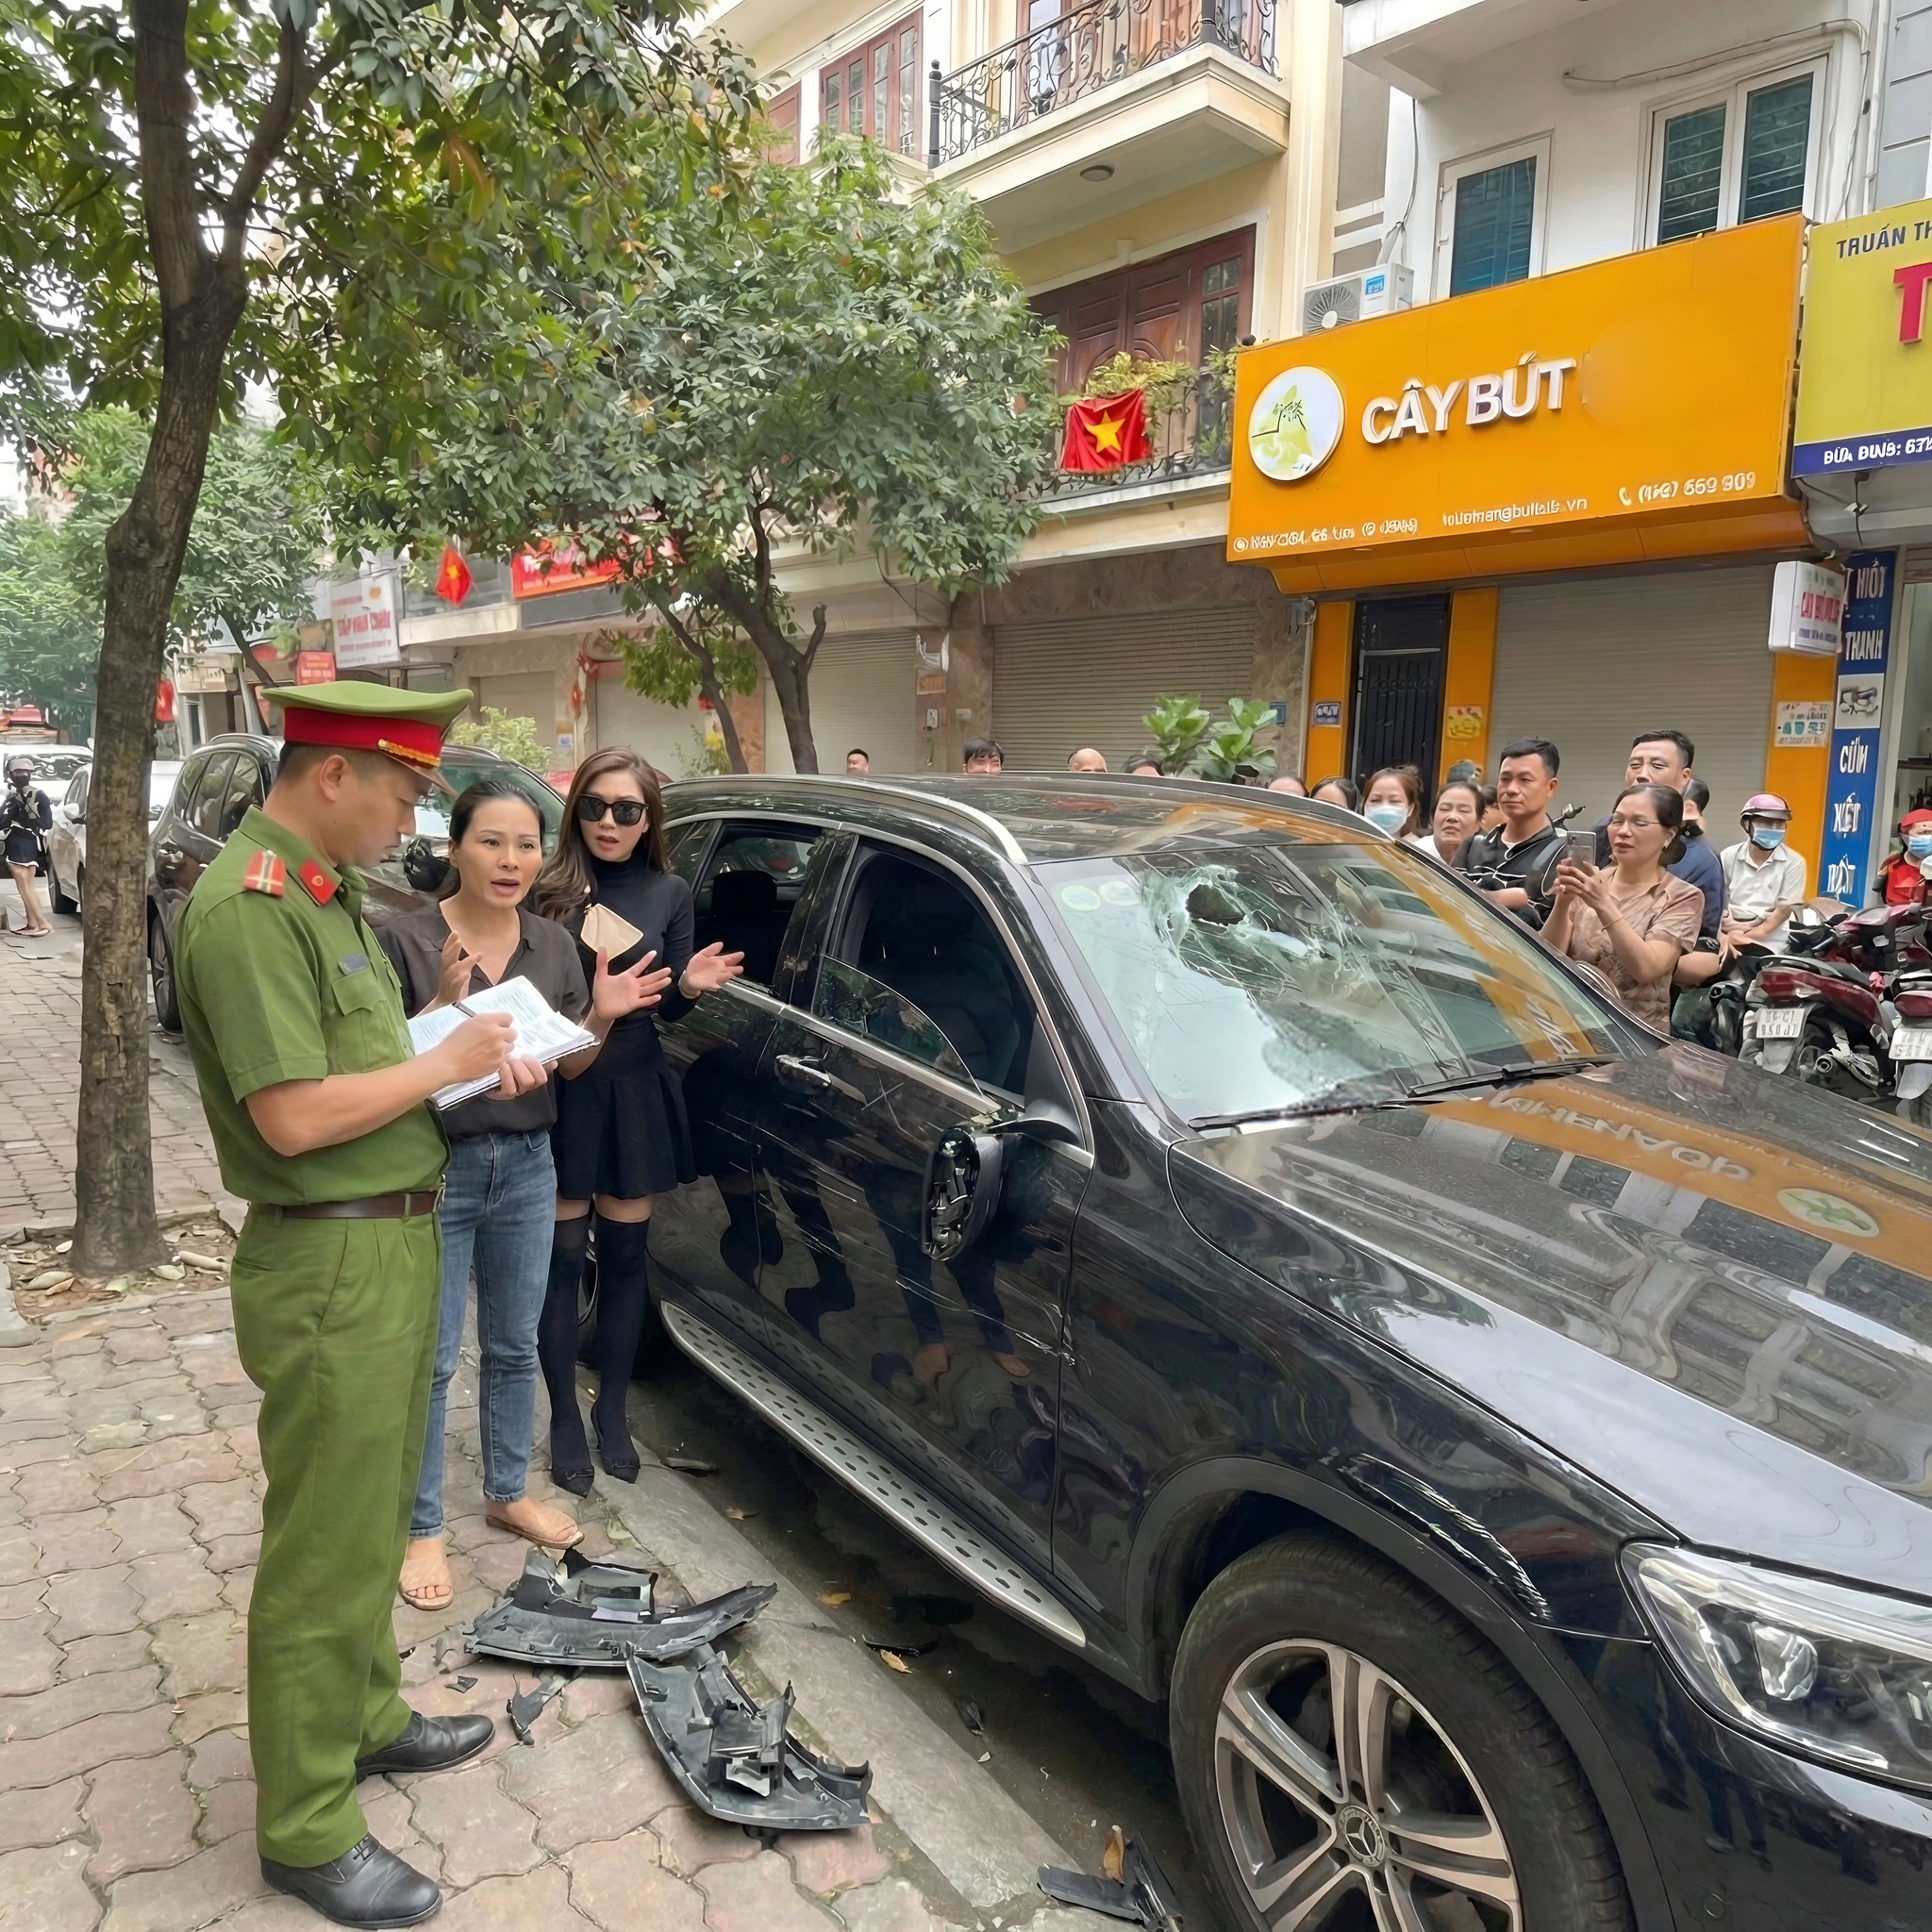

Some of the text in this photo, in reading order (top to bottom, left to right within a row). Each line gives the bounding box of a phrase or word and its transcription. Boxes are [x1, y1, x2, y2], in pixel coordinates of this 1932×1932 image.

[1360, 350, 1577, 444] CÂY BÚT
[1845, 629, 1884, 661] THANH
